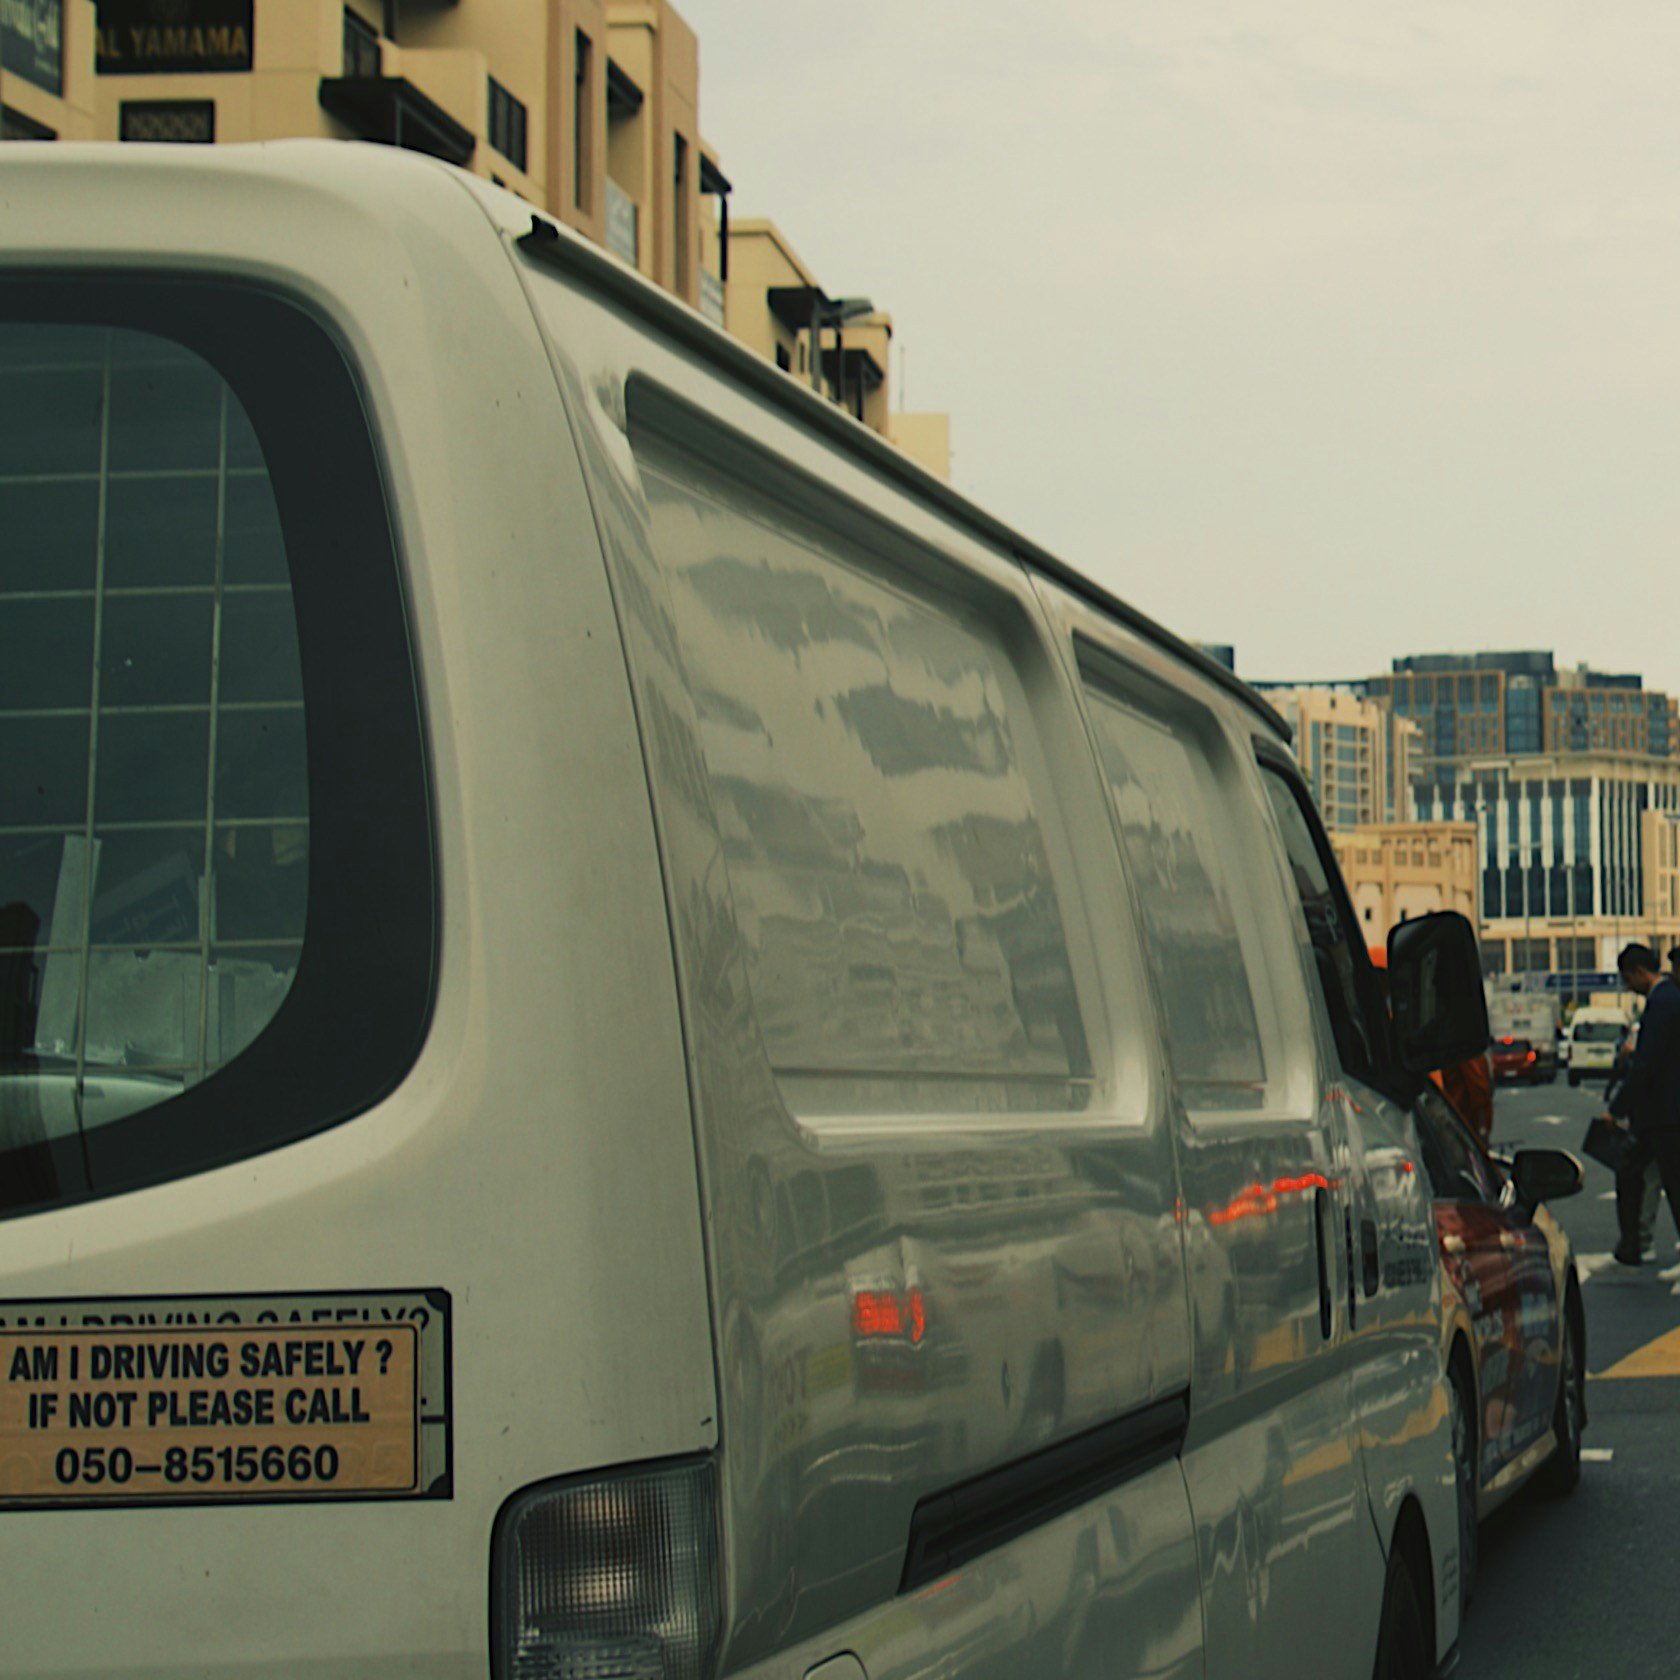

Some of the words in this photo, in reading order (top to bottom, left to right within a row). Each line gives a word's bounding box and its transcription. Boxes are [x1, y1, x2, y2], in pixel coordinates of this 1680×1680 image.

[130, 24, 248, 57] YAMAMA
[9, 1346, 59, 1381] AM
[69, 1345, 79, 1381] I
[90, 1343, 229, 1381] DRIVING
[239, 1340, 365, 1377] SAFELY
[28, 1393, 58, 1428] IF
[69, 1392, 137, 1428] NOT
[148, 1389, 275, 1426] PLEASE
[285, 1388, 370, 1424] CALL
[55, 1444, 340, 1484] 050-8515660
